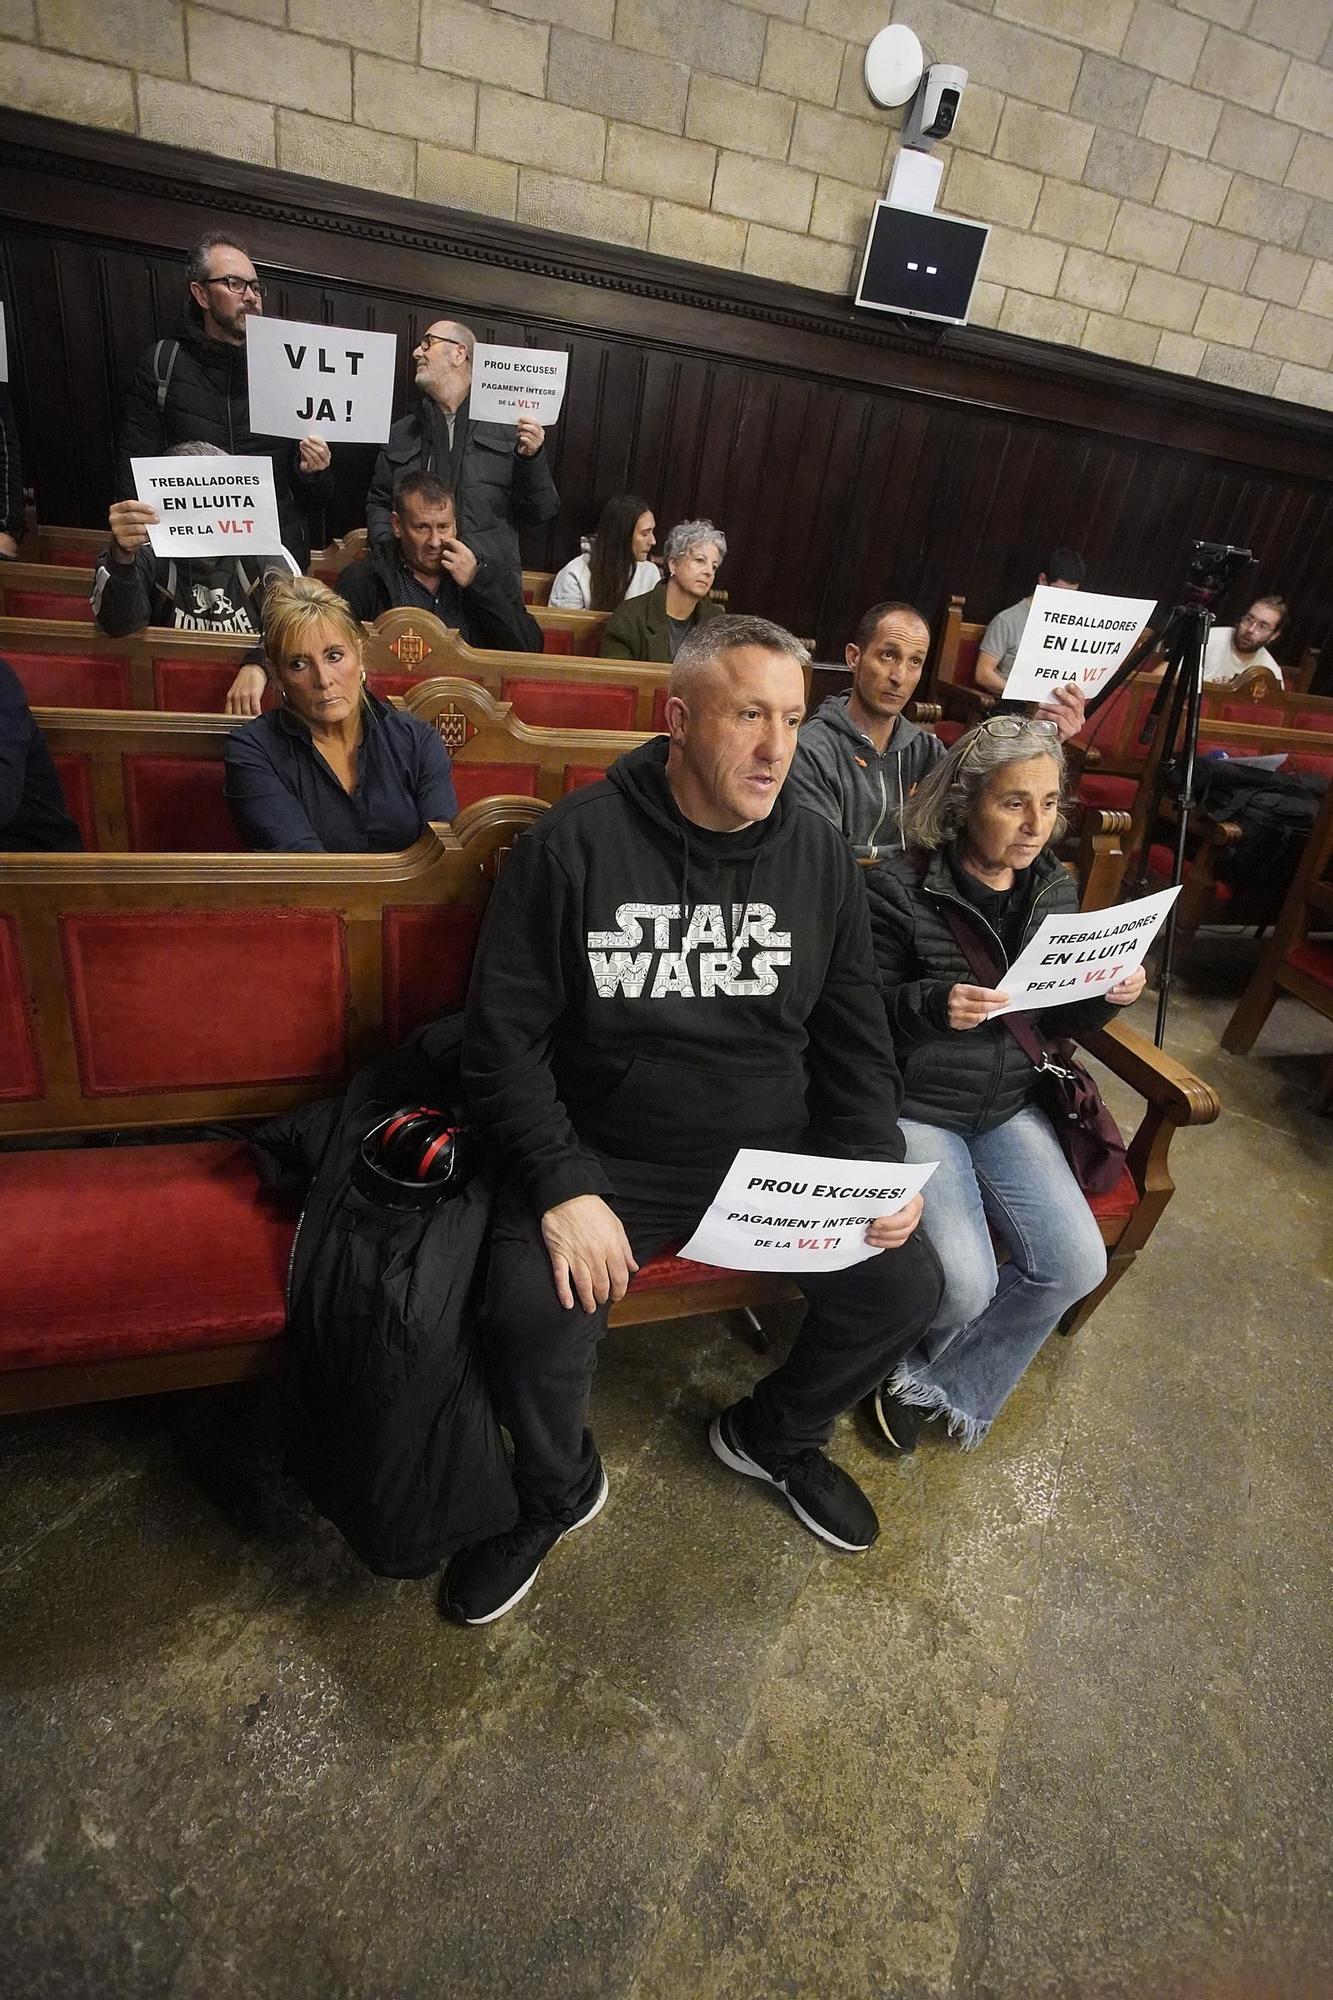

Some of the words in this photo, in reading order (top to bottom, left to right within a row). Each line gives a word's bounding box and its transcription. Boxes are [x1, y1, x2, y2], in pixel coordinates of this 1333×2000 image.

[484, 360, 511, 371] PROU
[513, 363, 557, 375] EXCUSES!
[481, 382, 524, 393] PAGAMENT
[517, 399, 540, 410] VLT!
[149, 476, 260, 488] TREBALLADORES
[162, 497, 187, 510] EN
[192, 495, 255, 509] LLUITA
[169, 525, 194, 535] PER
[197, 525, 214, 535] LA
[218, 520, 254, 534] VLT
[1044, 611, 1138, 631] TREBALLADORES
[1042, 634, 1068, 651] EN
[1070, 638, 1122, 655] LLUITA
[1034, 667, 1059, 679] PER
[1061, 671, 1077, 681] LA
[1083, 667, 1108, 682] VLT
[587, 902, 792, 950] STAR
[1048, 913, 1158, 945] TREBALLADORES
[1040, 952, 1073, 966] EN
[1075, 938, 1138, 964] LLUITA
[587, 950, 792, 999] WARS
[1026, 980, 1056, 992] PER
[1058, 977, 1077, 988] LA
[1083, 964, 1124, 984] VLT
[747, 1177, 808, 1195] PROU
[811, 1185, 907, 1199] EXCUSES!
[726, 1212, 820, 1229] PAGAMENT
[754, 1238, 772, 1248] DE
[775, 1239, 791, 1249] LA
[797, 1237, 841, 1250] VLT!
